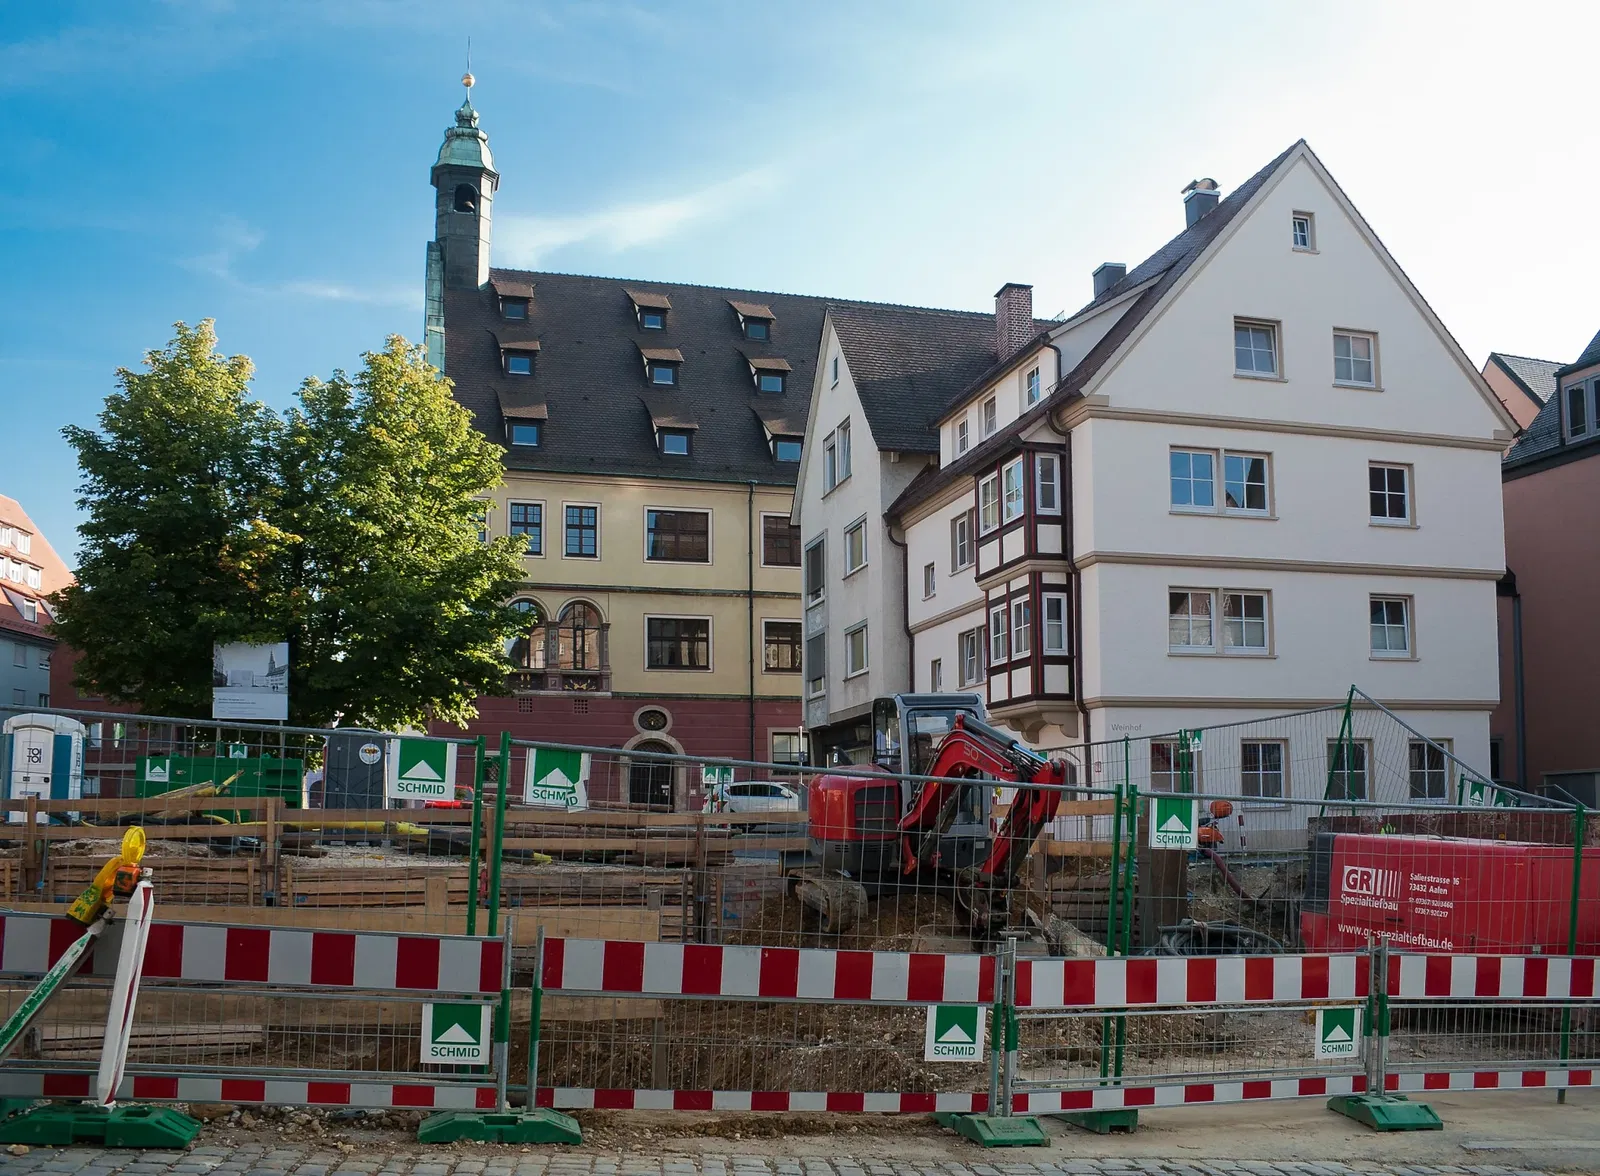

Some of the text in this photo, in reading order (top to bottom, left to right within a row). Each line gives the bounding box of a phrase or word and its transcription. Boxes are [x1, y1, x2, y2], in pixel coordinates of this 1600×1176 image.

[1111, 723, 1142, 731] Weinhof
[27, 747, 42, 756] TOI
[26, 755, 42, 764] TOI
[397, 782, 446, 795] SCHMID
[532, 789, 578, 806] SCHMID
[1156, 834, 1192, 844] SCHMID
[1345, 868, 1373, 893] GR
[1410, 872, 1450, 885] Salierstrasse
[1409, 882, 1448, 895] 73432 Aalen
[1340, 893, 1399, 911] Spezialtiefbau
[430, 1046, 481, 1058] SCHMID
[933, 1045, 976, 1056] SCHMID
[1321, 1043, 1354, 1054] SCHMID
